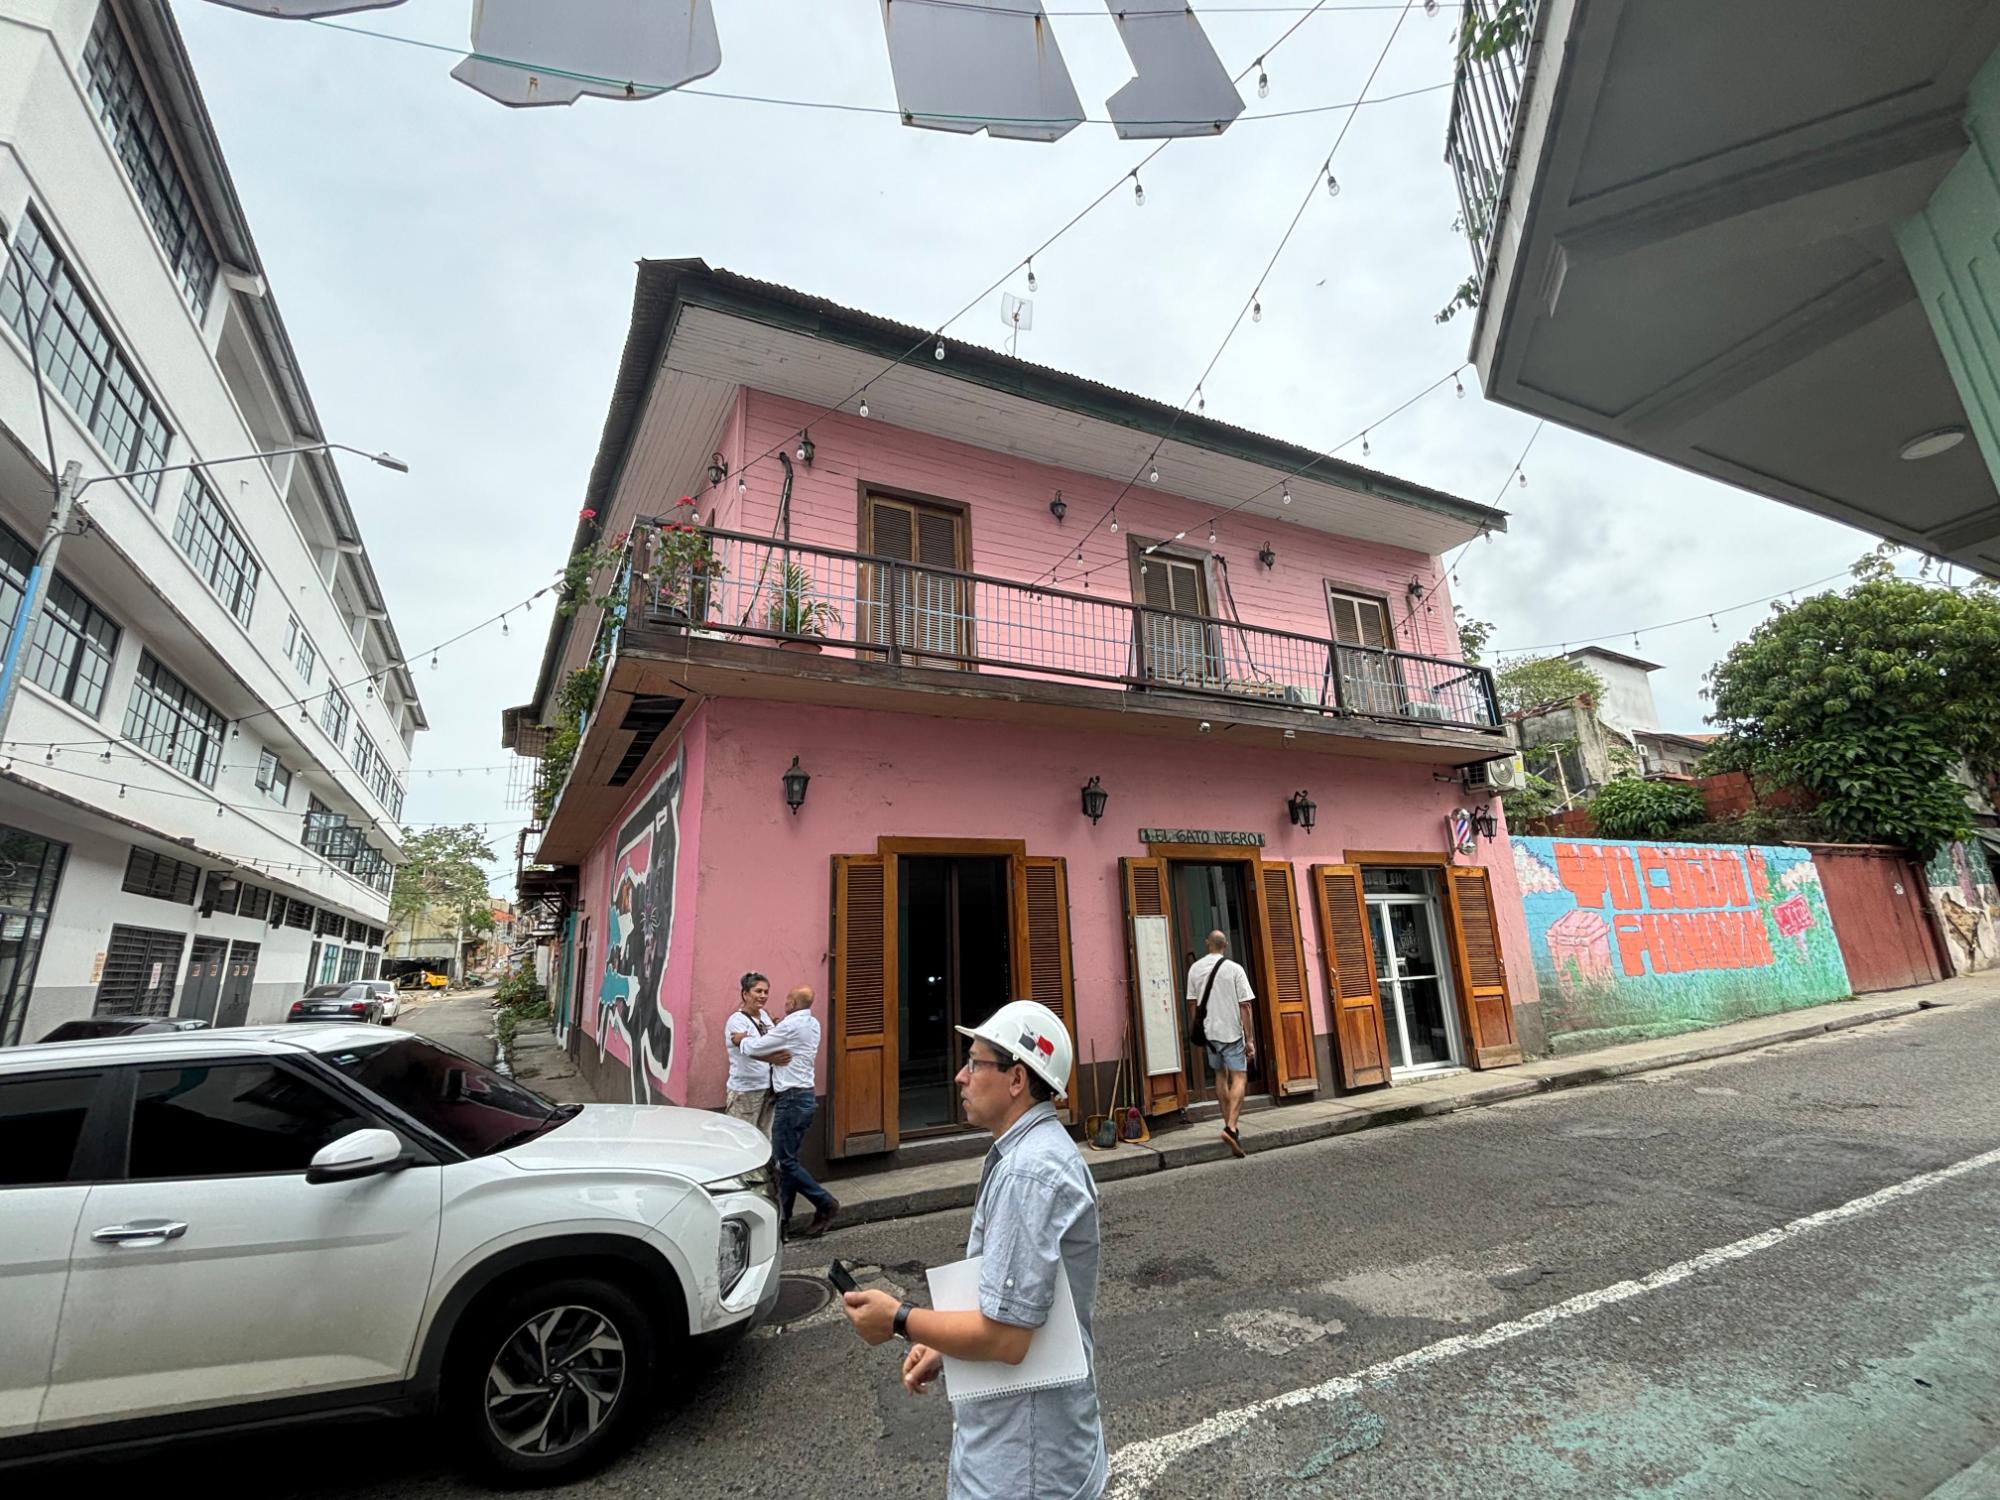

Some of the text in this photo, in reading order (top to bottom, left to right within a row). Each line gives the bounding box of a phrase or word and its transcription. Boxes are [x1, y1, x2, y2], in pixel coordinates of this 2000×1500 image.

[1155, 830, 1256, 846] EL GATO NEGRO
